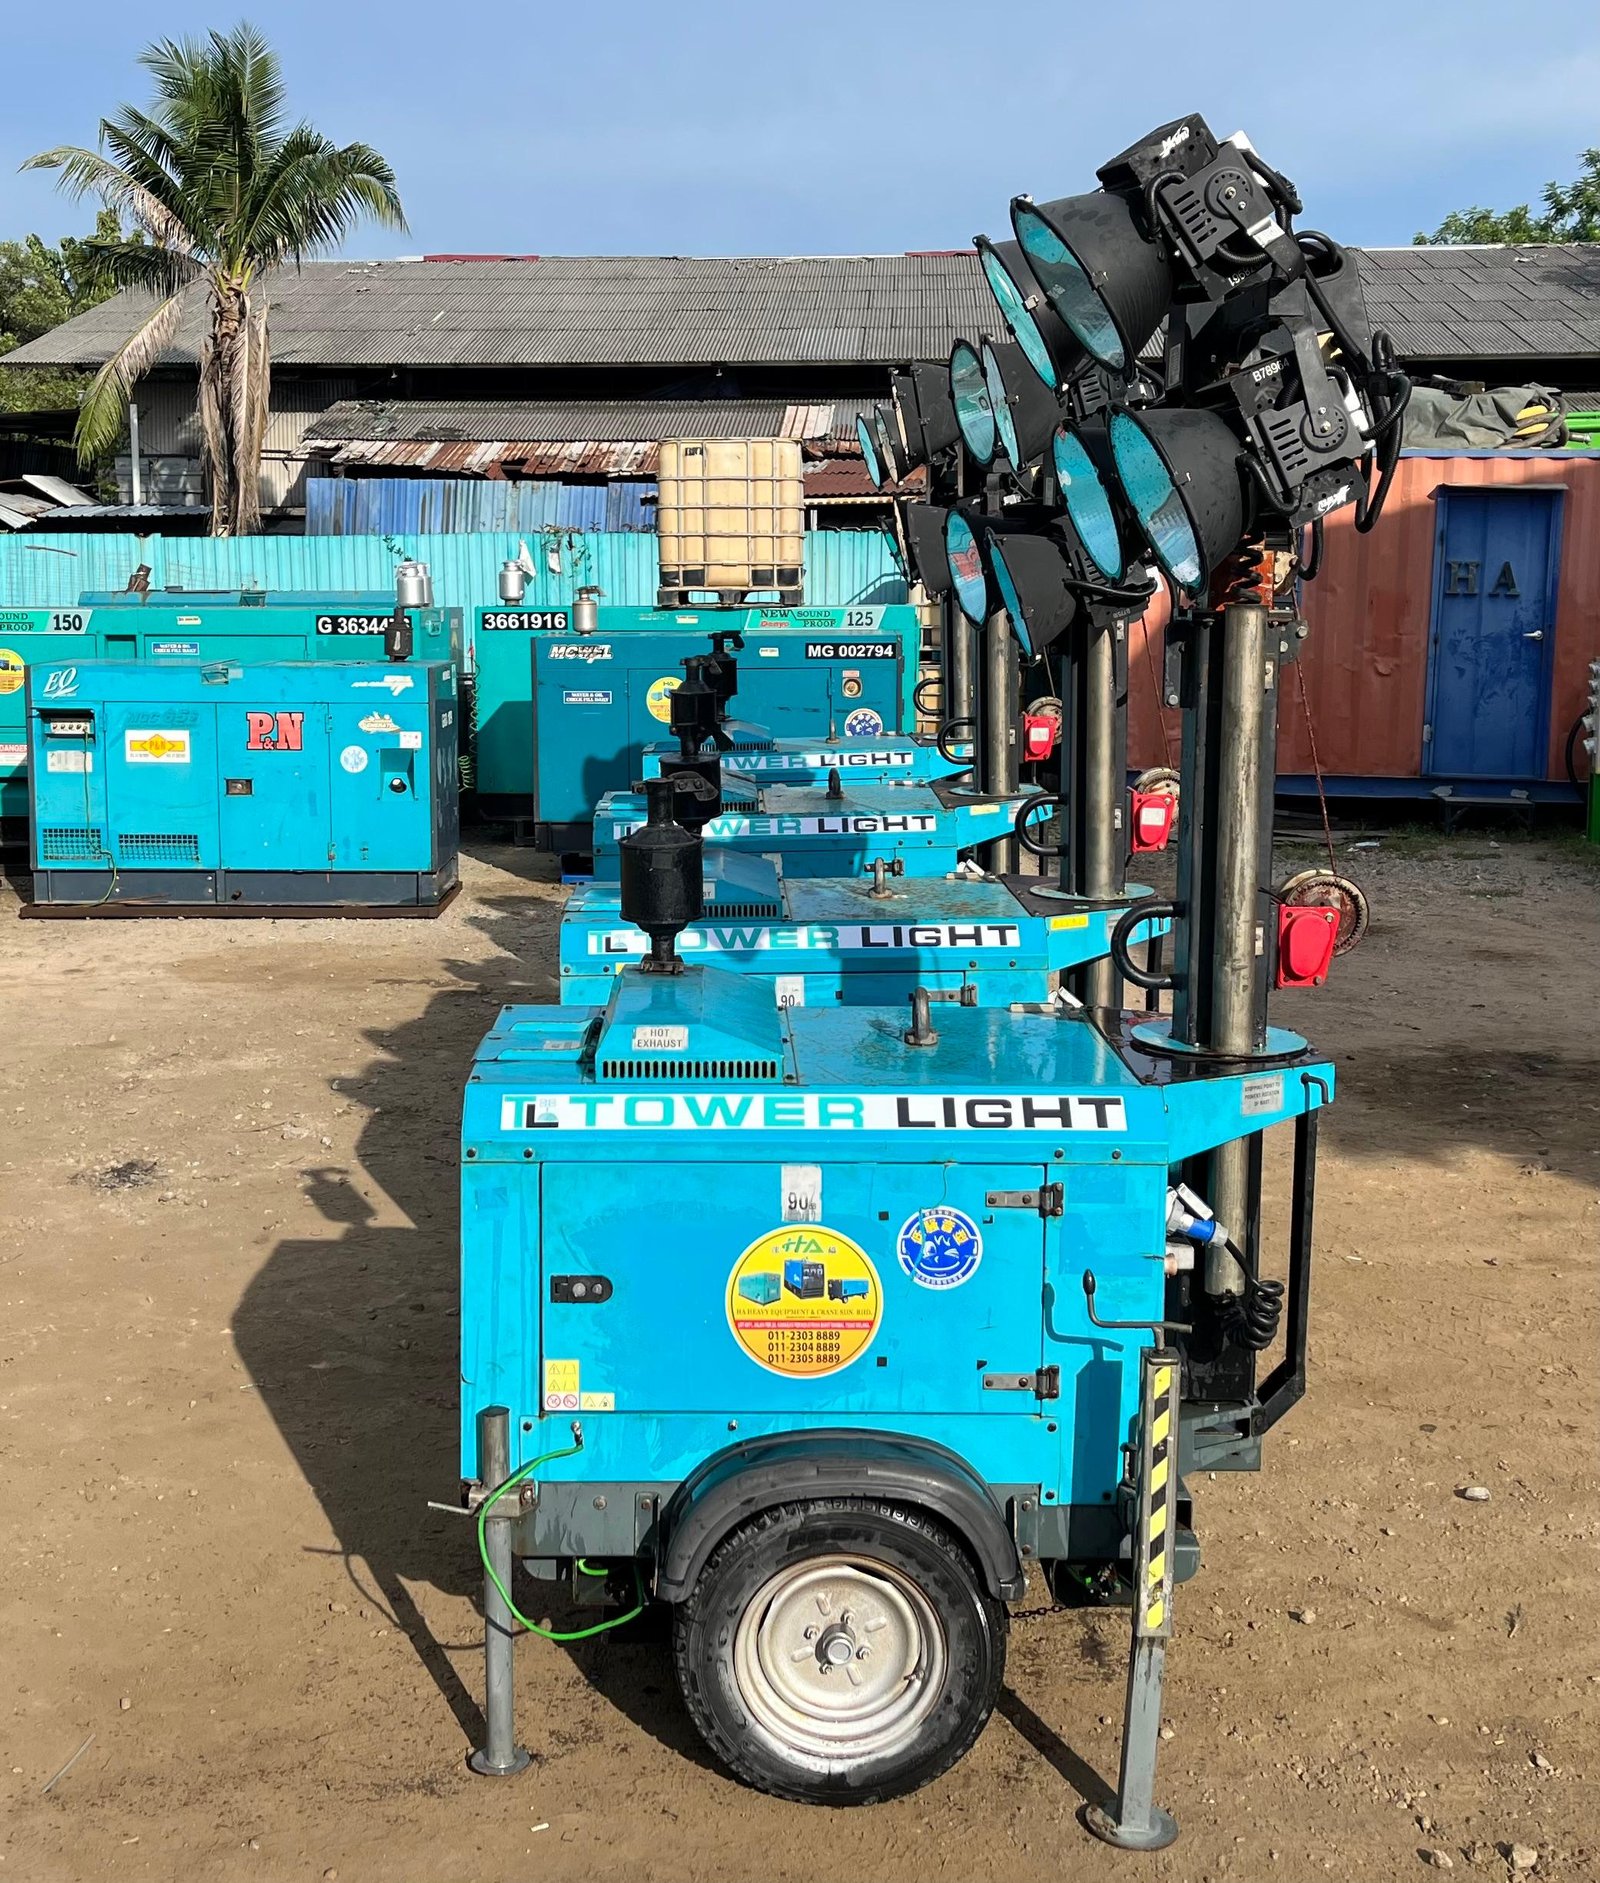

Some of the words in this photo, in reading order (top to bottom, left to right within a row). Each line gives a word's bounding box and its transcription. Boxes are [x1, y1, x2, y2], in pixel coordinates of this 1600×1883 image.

[1252, 359, 1289, 382] B78964
[484, 613, 566, 629] 3661916
[760, 609, 790, 618] NEW
[847, 611, 873, 627] 125
[0, 623, 34, 631] PROOF
[53, 614, 82, 631] 150
[318, 617, 332, 634] G
[337, 617, 410, 634] 36344
[803, 619, 836, 627] PROOF
[808, 645, 834, 657] MG
[838, 645, 893, 657] 002794
[43, 667, 79, 699] EQ
[246, 712, 304, 751] P&N
[722, 755, 807, 769] WER
[820, 752, 912, 767] LIGHT
[711, 816, 801, 836] WER
[817, 815, 934, 834] LIGHT
[861, 925, 1017, 948] LIGHT
[781, 994, 795, 1007] 90
[650, 1028, 670, 1038] HOT
[637, 1039, 683, 1049] EXHAUST
[569, 1095, 864, 1127] TOWER
[896, 1096, 1122, 1128] LIGHT
[788, 1191, 808, 1210] 90
[747, 1308, 769, 1316] HEAVY
[770, 1308, 810, 1316] EQUIPMENT
[810, 1308, 815, 1316] &
[816, 1308, 838, 1316] CRANE
[768, 1330, 814, 1340] 011-2303
[816, 1330, 841, 1340] 8889
[768, 1342, 814, 1352] 011-2304
[816, 1342, 841, 1352] 8889
[768, 1353, 814, 1364] 011-2305
[816, 1353, 841, 1364] 8889
